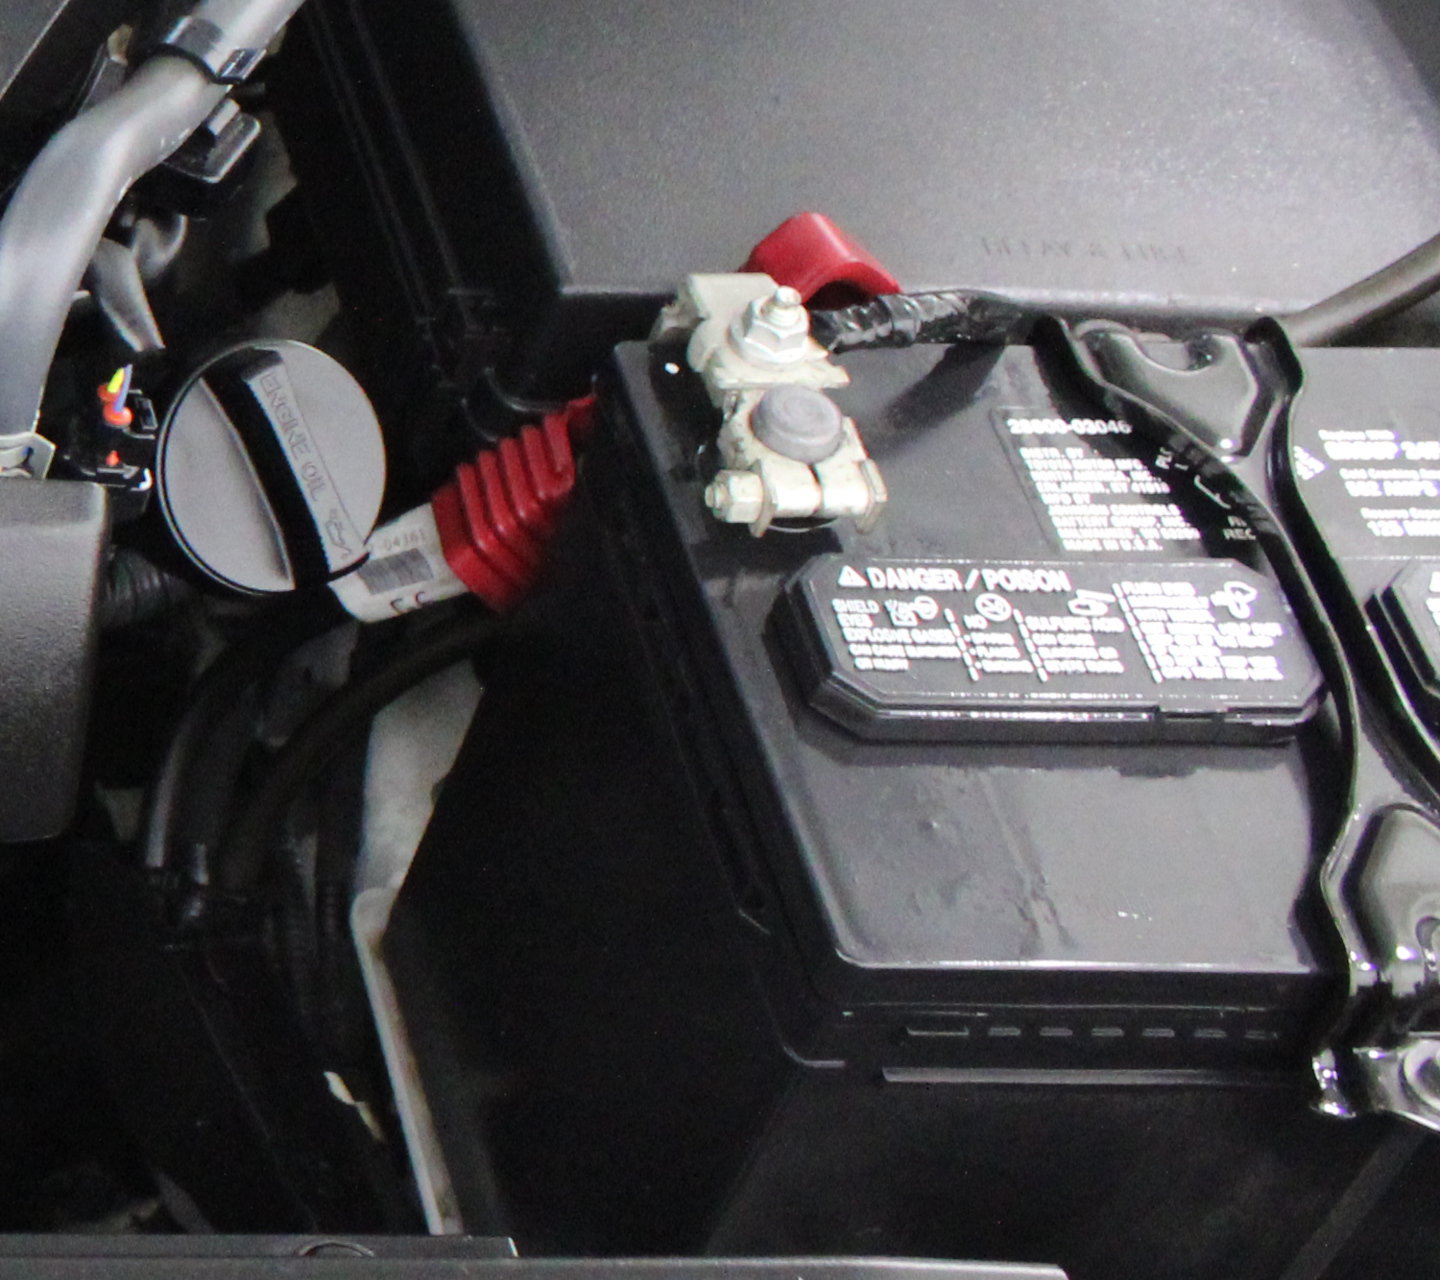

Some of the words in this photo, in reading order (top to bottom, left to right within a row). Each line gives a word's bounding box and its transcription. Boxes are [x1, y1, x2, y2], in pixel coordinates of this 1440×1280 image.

[260, 373, 312, 460] ENGINE
[300, 461, 328, 502] OIL
[866, 567, 964, 591] DANGER
[964, 568, 980, 592] /
[981, 568, 1071, 593] POISON
